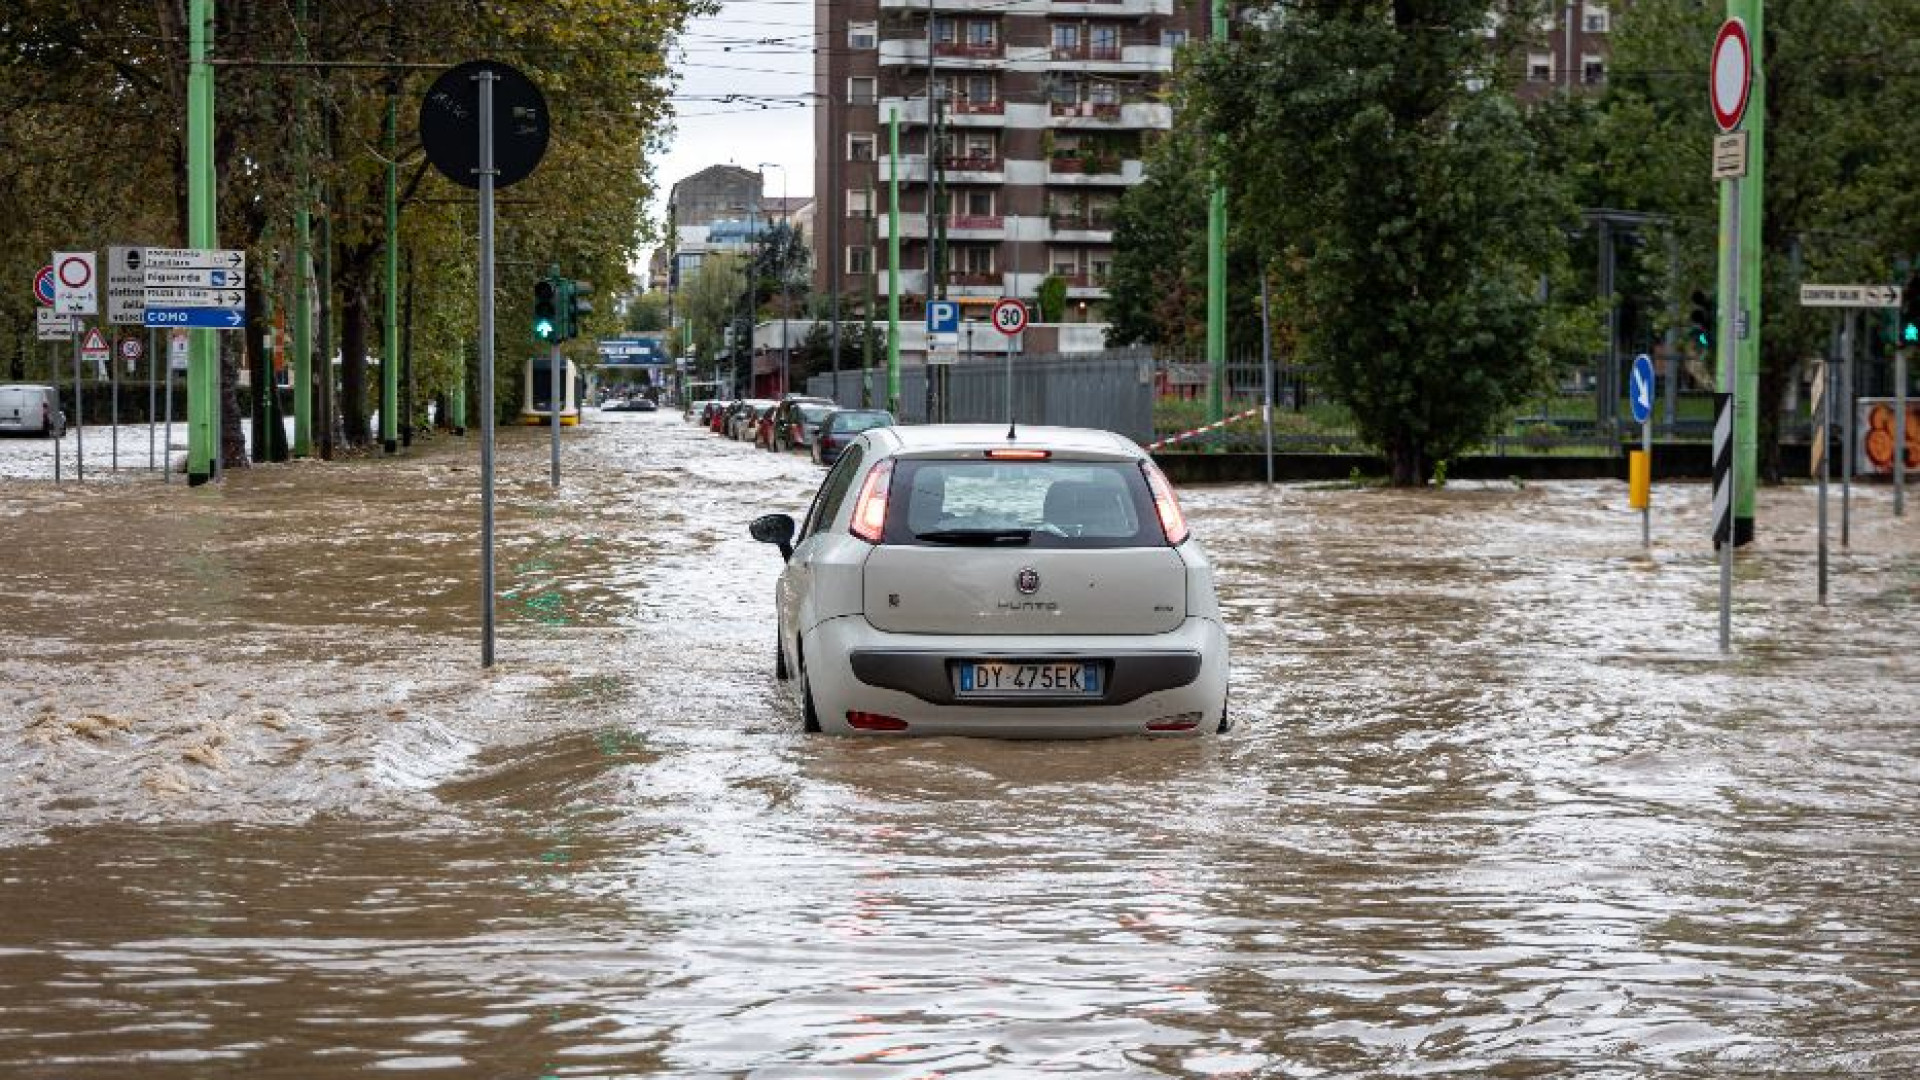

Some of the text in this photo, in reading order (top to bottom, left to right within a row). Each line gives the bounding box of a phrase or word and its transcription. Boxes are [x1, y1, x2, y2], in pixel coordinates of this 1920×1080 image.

[147, 312, 188, 322] COMO
[932, 303, 953, 330] P
[1001, 308, 1020, 326] 30
[976, 665, 1081, 688] DY 475EK
